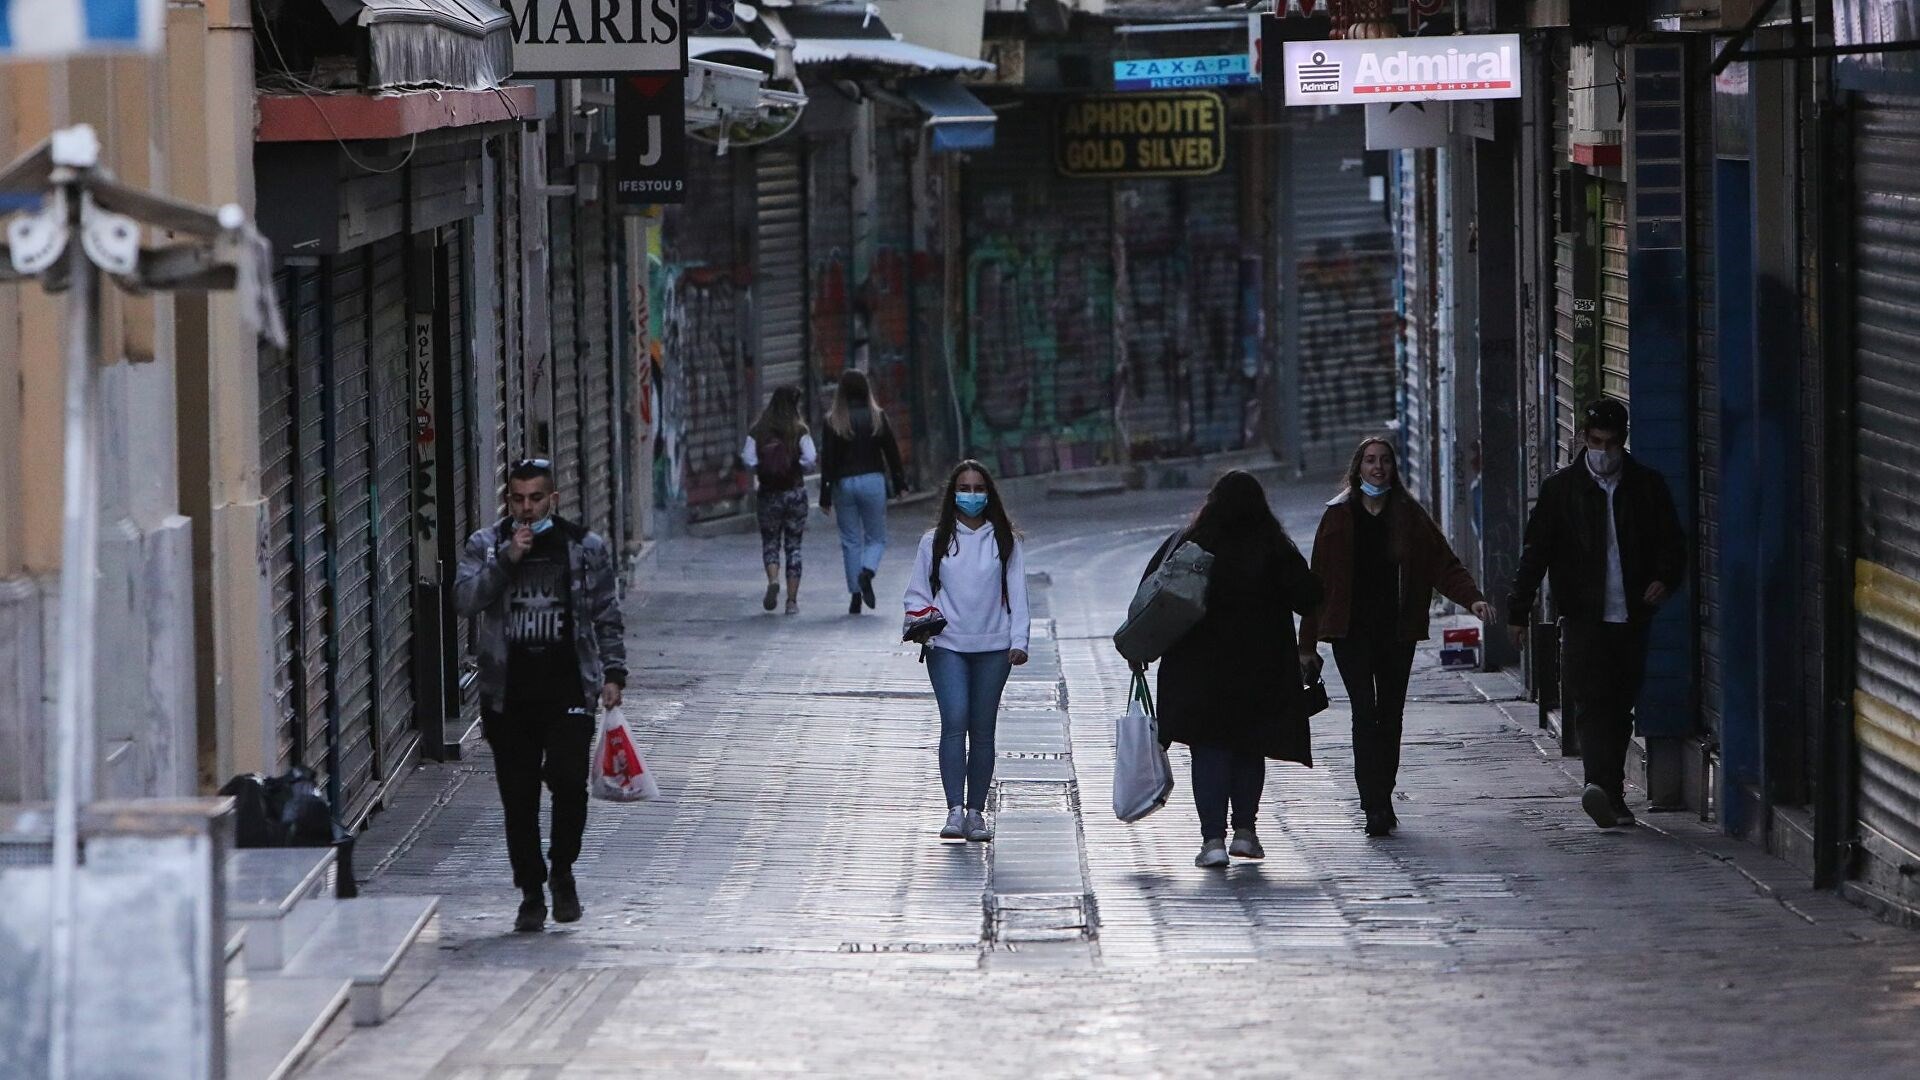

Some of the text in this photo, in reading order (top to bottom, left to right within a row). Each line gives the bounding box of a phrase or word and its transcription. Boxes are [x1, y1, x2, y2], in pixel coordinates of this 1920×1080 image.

[1354, 46, 1511, 84] Admiral
[1151, 75, 1229, 88] RECORDS
[1301, 82, 1339, 92] Admiral
[1374, 82, 1491, 92] SPORT SHOPS
[1066, 99, 1215, 133] APHRODITE
[640, 115, 661, 166] J
[1067, 137, 1214, 169] GOLD SILVER
[619, 180, 683, 192] IFESTOU 9
[510, 608, 565, 641] WHITE
